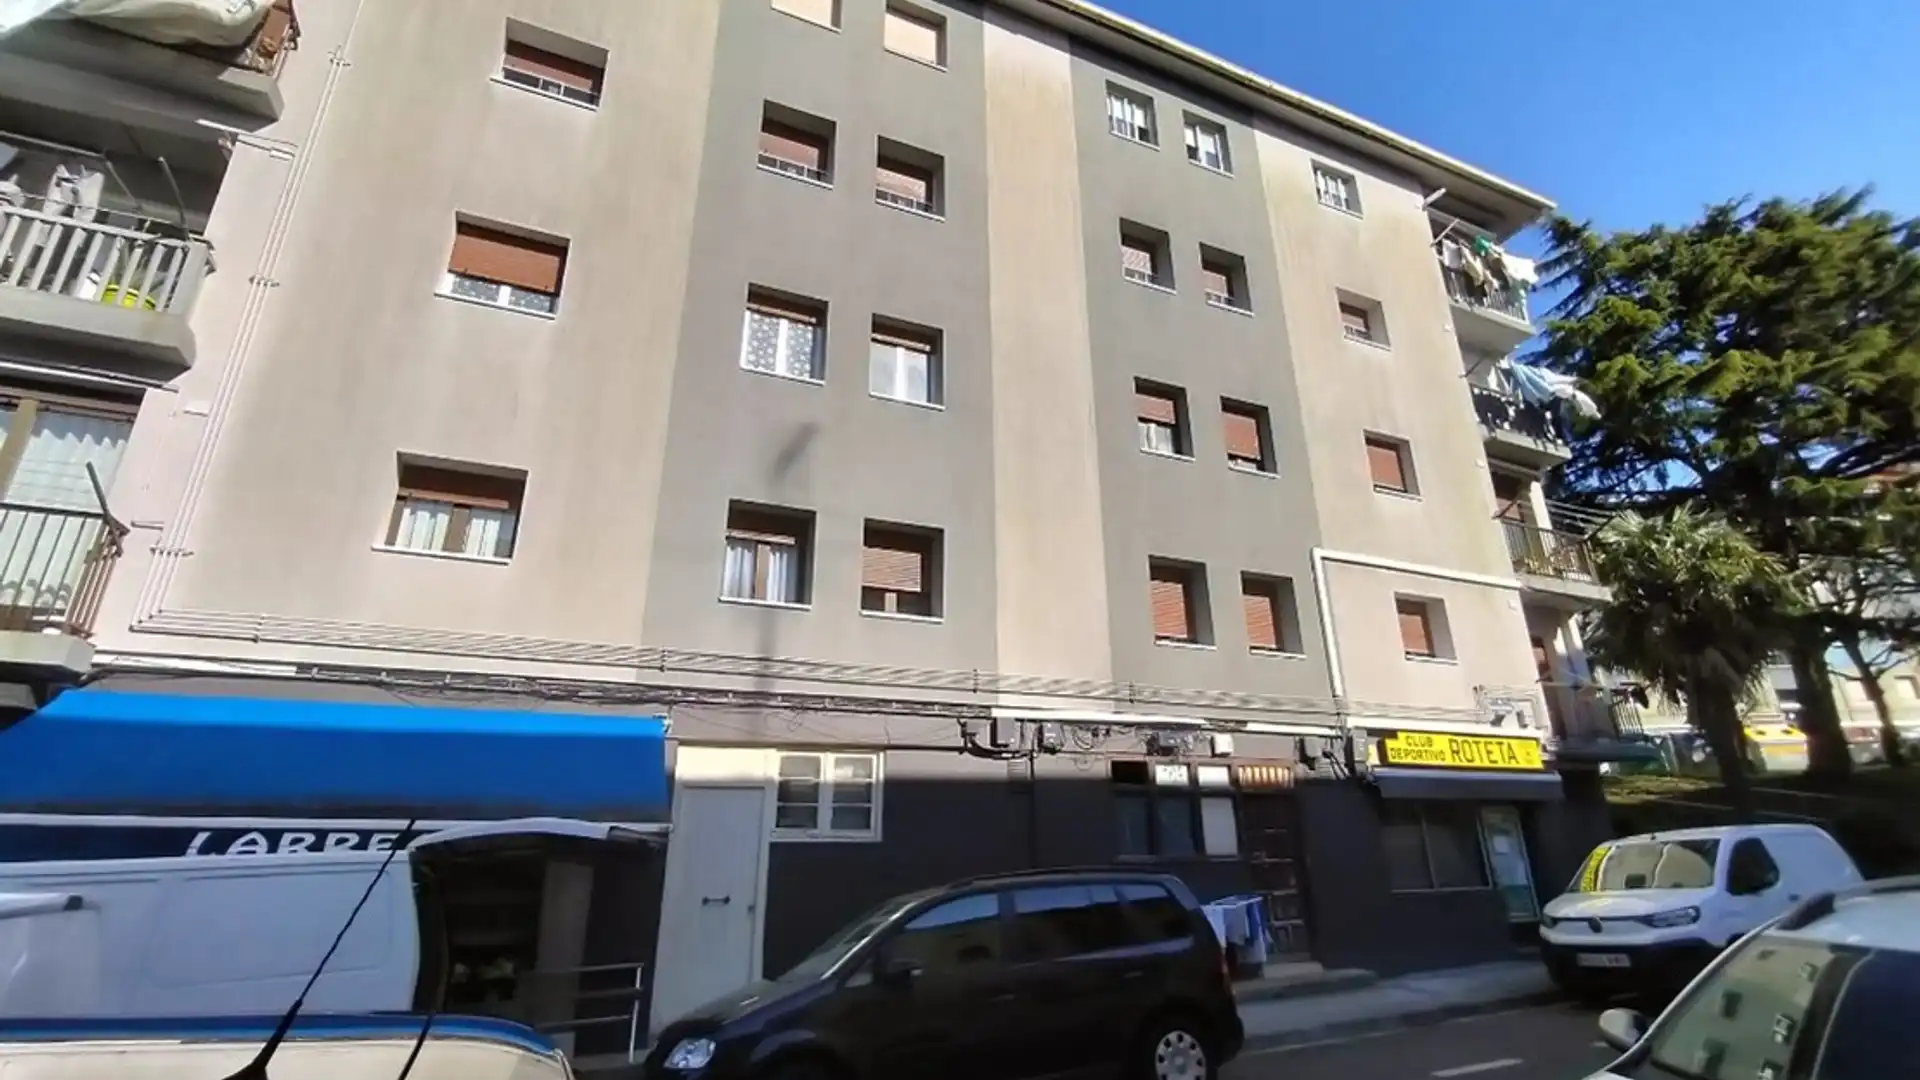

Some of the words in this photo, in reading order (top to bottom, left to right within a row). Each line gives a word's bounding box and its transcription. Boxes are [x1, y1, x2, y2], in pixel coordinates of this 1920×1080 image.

[1405, 735, 1434, 748] CLUB
[1389, 747, 1447, 762] DEPORTIVO
[1448, 738, 1520, 765] ROTETA
